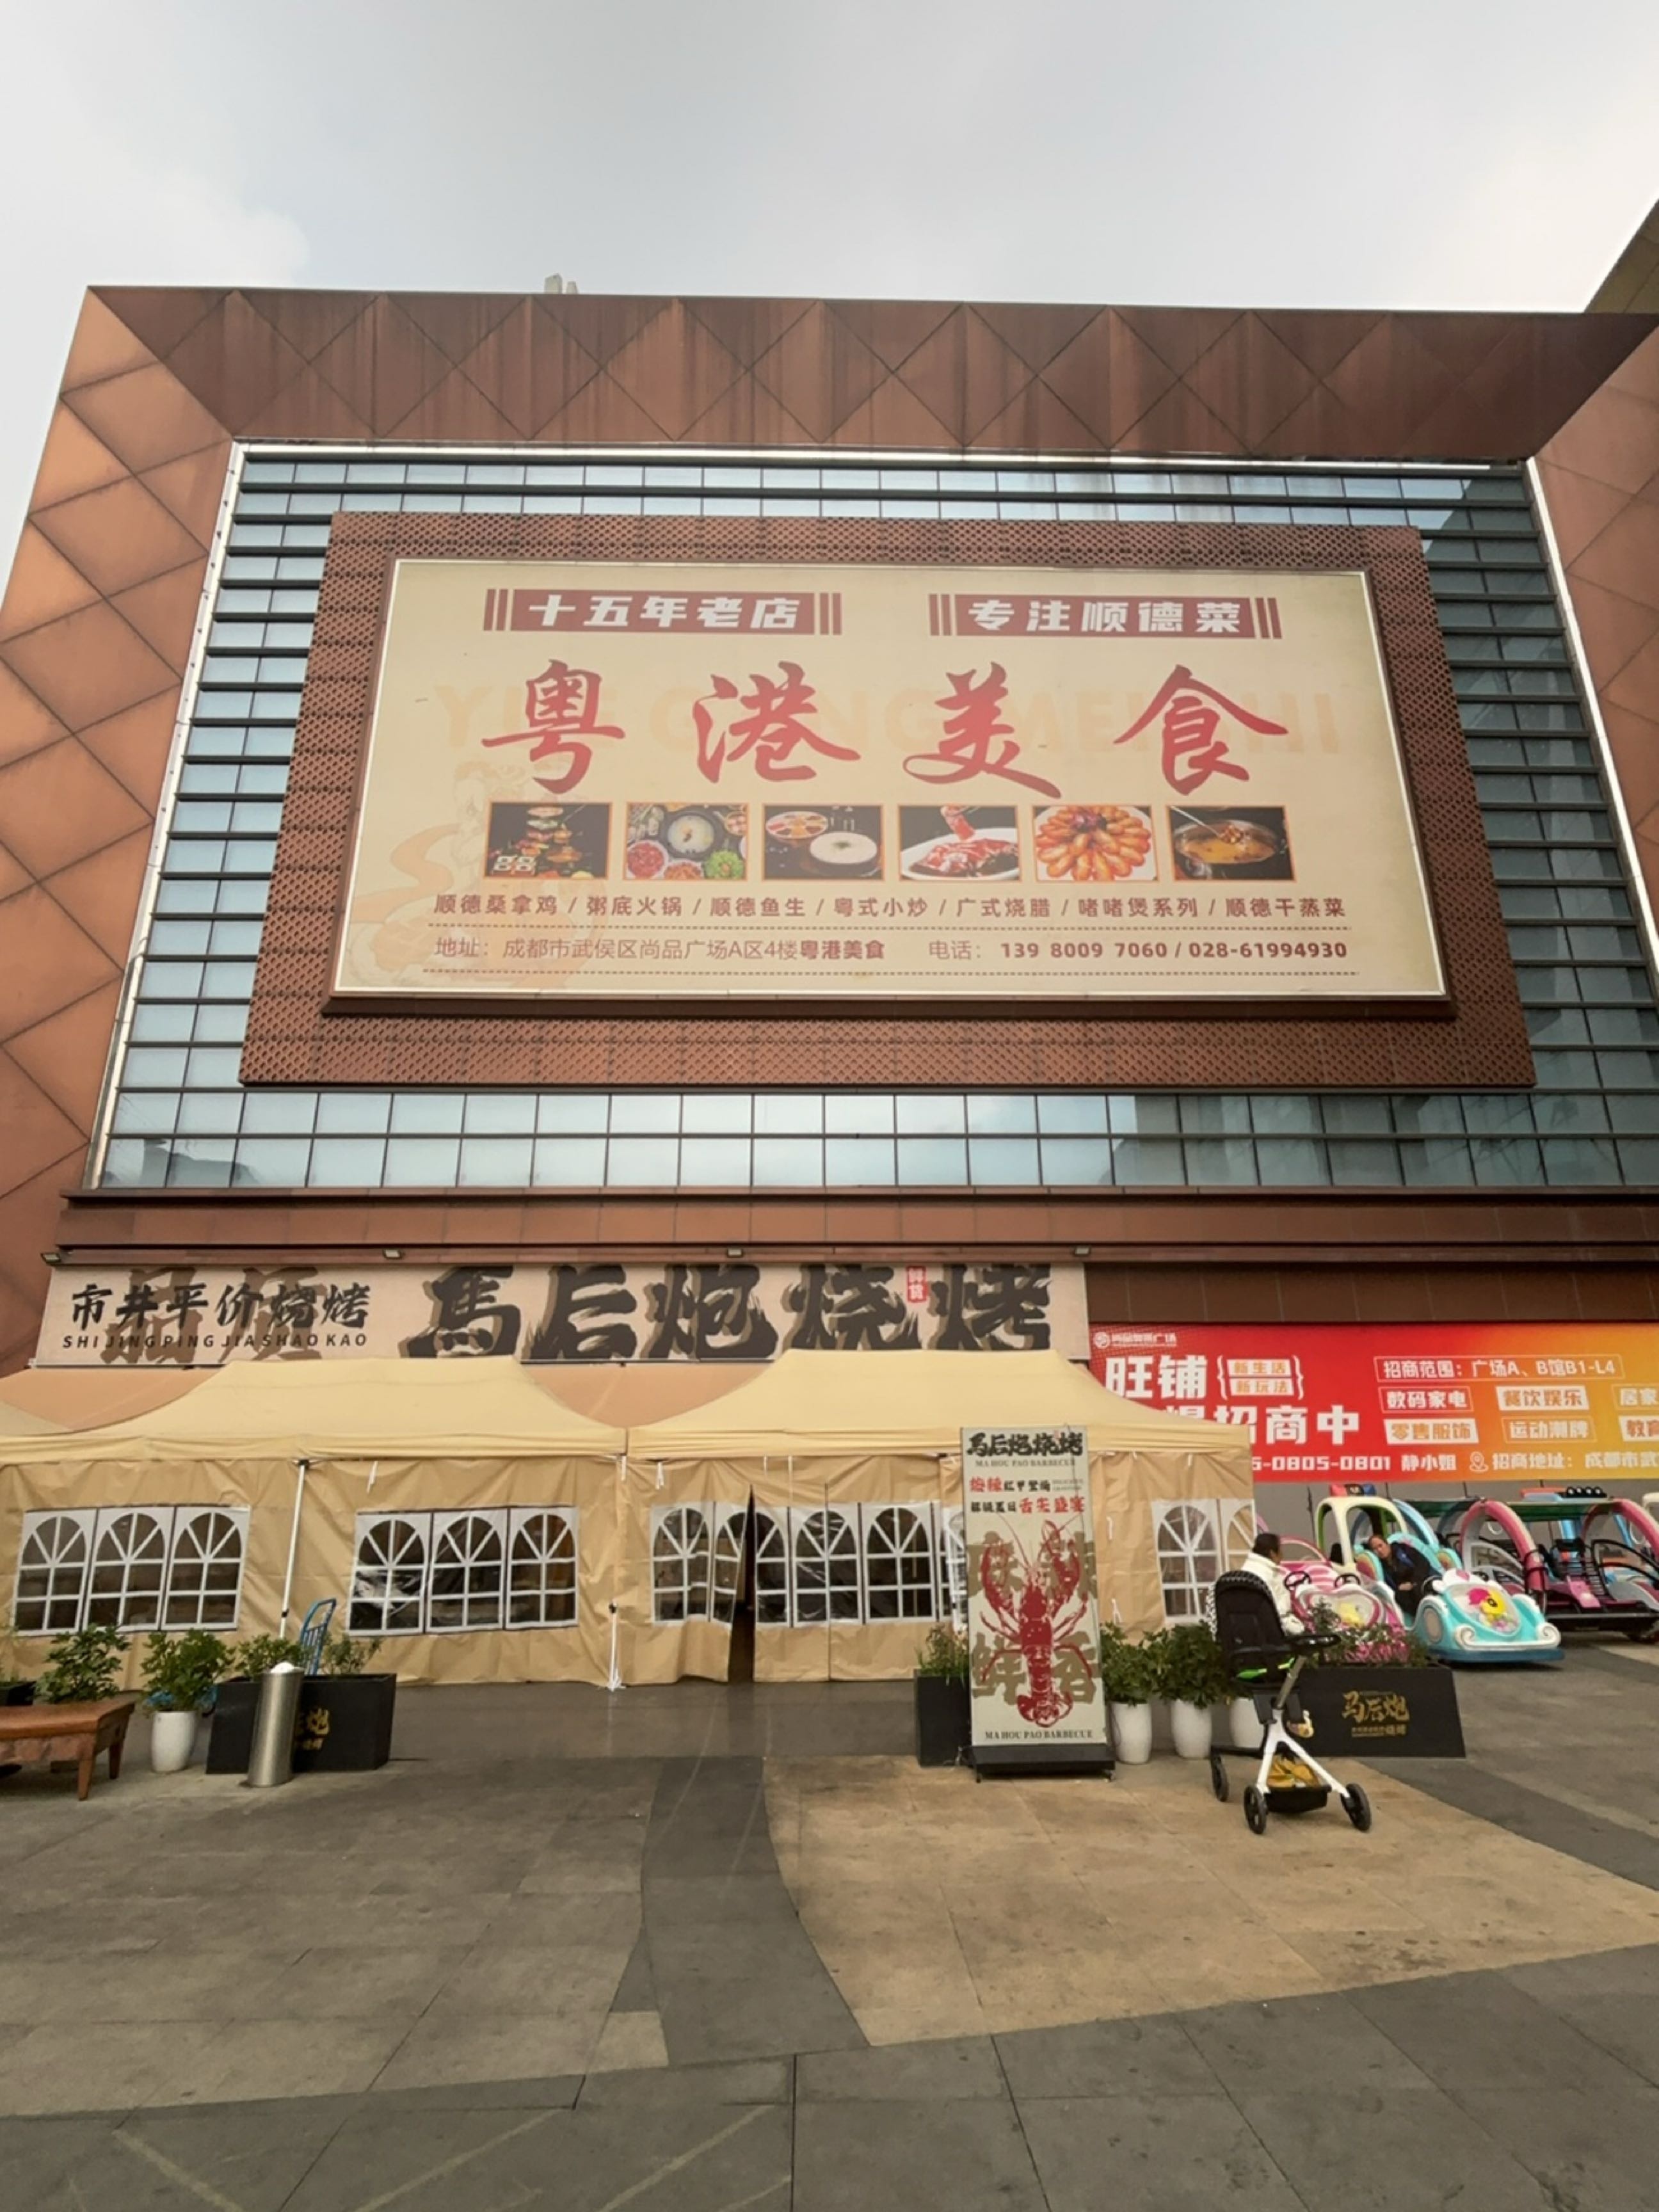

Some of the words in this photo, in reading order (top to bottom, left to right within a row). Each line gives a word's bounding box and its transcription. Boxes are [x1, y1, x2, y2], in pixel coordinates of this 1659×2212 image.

[529, 594, 800, 629] 十五年老店
[967, 599, 1241, 633] 专注顺德菜
[482, 659, 1288, 799] 粤港美食
[433, 894, 557, 916] 顺德桑拿鸡
[586, 895, 682, 917] 粥底火锅
[710, 897, 806, 917] 顺德鱼生
[834, 897, 928, 918] 粤式小炒
[956, 897, 1050, 918] 广式烧腊
[1225, 897, 1345, 917] 顺德干蒸菜
[1000, 942, 1039, 959] 139
[1050, 942, 1103, 959] 8009
[1115, 942, 1167, 958] 7060
[1189, 942, 1347, 959] 028-61994930
[72, 1282, 371, 1331] 市井平价烧烤
[326, 1334, 367, 1347] KAO
[1105, 1354, 1208, 1400] 旺铺
[1386, 1390, 1467, 1409] 数码家电
[1504, 1389, 1583, 1407] 餐饮娱乐
[1391, 1422, 1471, 1440] 零售服饰
[1510, 1420, 1589, 1439] 运动潮牌
